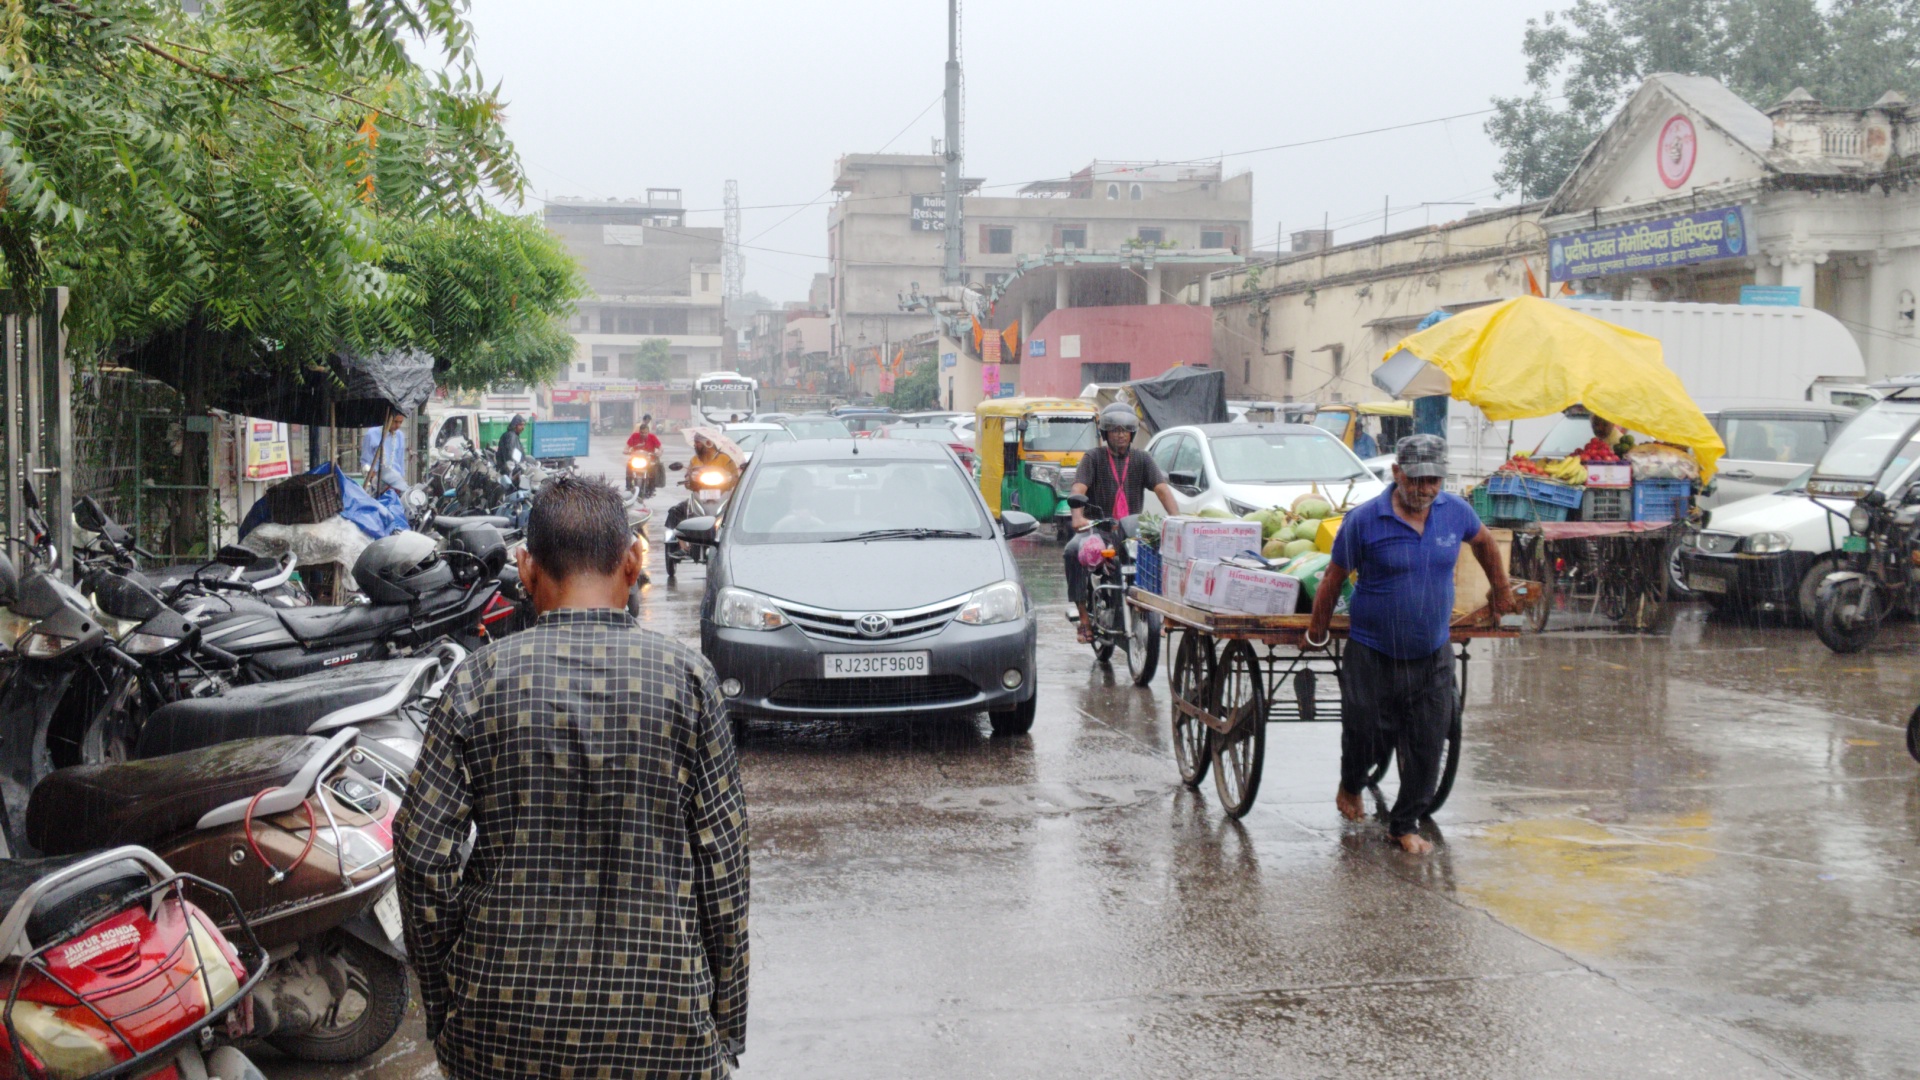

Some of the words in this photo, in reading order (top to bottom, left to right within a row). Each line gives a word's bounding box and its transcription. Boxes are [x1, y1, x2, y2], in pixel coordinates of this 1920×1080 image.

[923, 197, 946, 207] Italia
[1565, 238, 1590, 266] प्रदीप
[1591, 238, 1616, 259] रावत
[1618, 226, 1669, 254] मेमोरियल
[1671, 218, 1723, 248] हॉस्पिटल
[1193, 526, 1230, 535] Himachal
[1232, 527, 1257, 536] Apple
[1229, 570, 1267, 584] Himachal
[1269, 578, 1294, 589] Apple
[835, 656, 925, 673] RJ23CF9609
[64, 935, 100, 959] JAIPUR
[100, 924, 138, 939] HONDA
